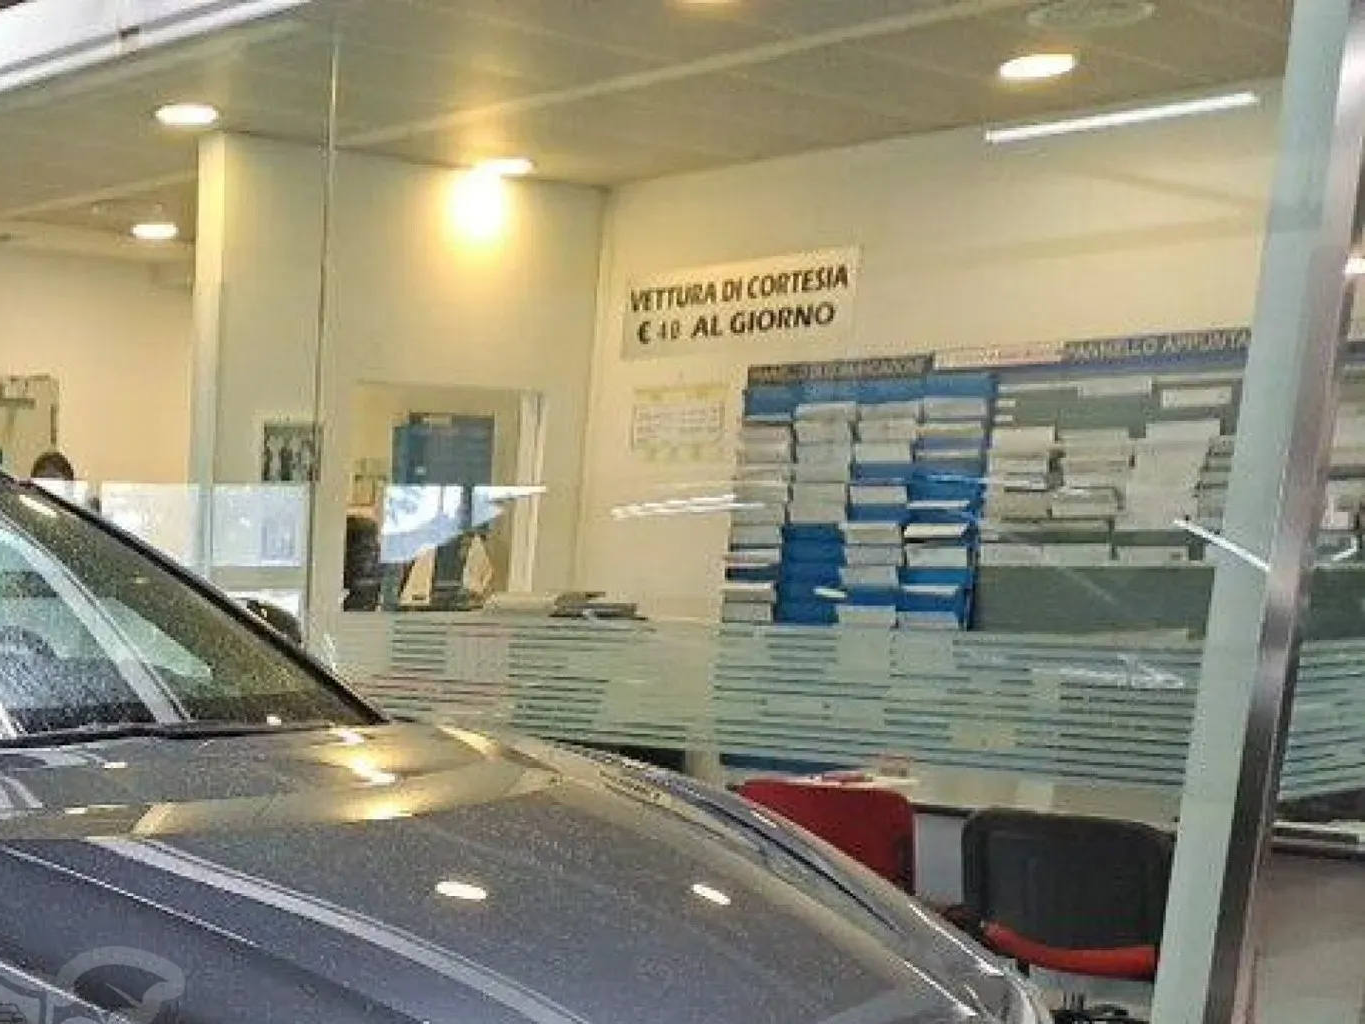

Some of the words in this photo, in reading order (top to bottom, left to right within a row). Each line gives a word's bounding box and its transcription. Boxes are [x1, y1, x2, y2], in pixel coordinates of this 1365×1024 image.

[630, 284, 717, 313] VETTURA
[721, 278, 743, 303] DI
[746, 264, 848, 299] CORTESIA
[637, 319, 652, 345] €
[690, 314, 724, 339] AL
[730, 301, 836, 335] GIORNO
